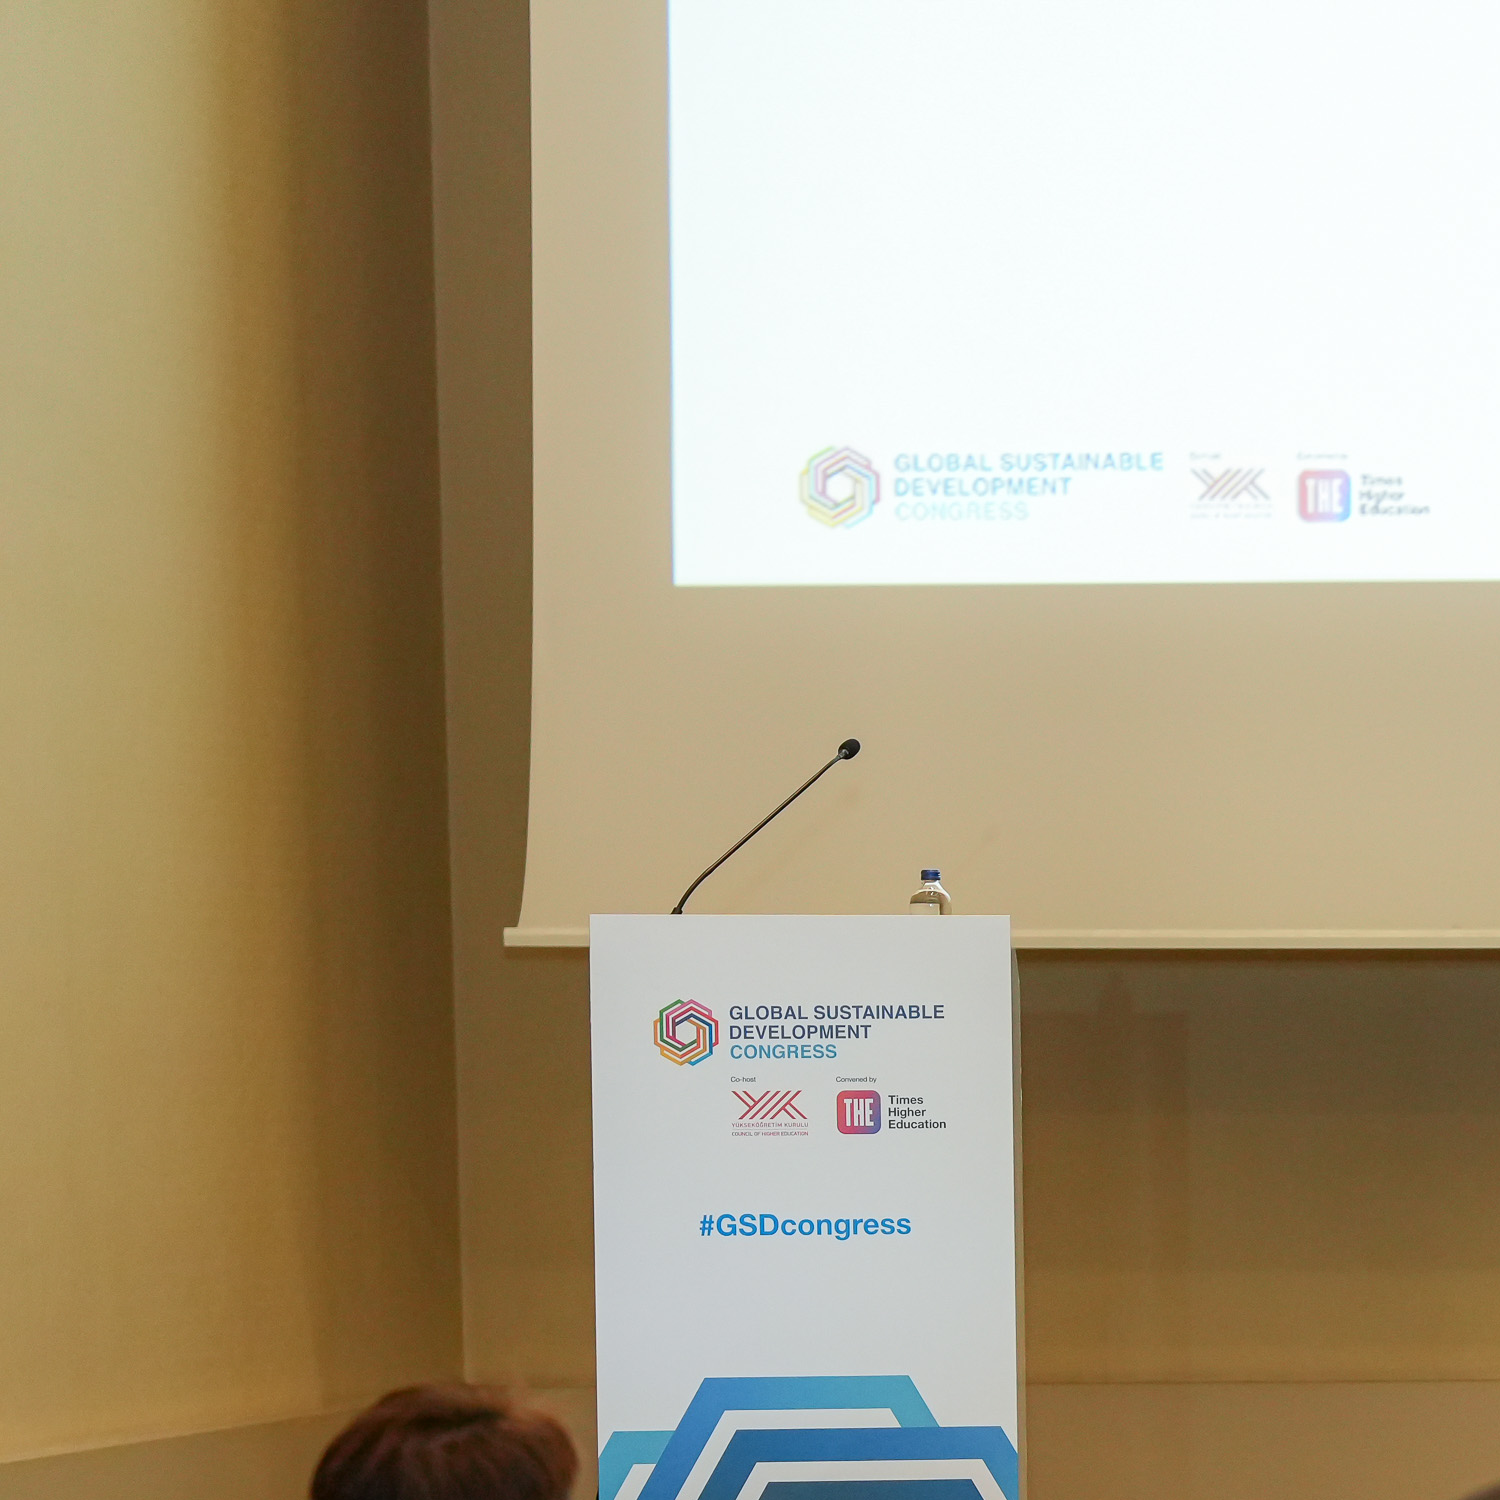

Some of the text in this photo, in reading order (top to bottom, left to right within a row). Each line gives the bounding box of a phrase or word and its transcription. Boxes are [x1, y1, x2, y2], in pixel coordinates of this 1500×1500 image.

[893, 452, 993, 472] GLOBAL
[1000, 451, 1165, 472] SUSTAINABLE
[893, 476, 1073, 497] DEVELOPMENT
[893, 501, 1031, 521] CONGRESS
[1359, 503, 1431, 516] Education
[729, 1004, 945, 1021] GLOBAL SUSTAINABLE
[729, 1024, 872, 1040] DEVELOPMENT
[729, 1044, 838, 1060] CONGRESS
[730, 1076, 757, 1084] Co-host
[868, 1076, 877, 1084] by
[887, 1094, 924, 1105] Times
[843, 1097, 875, 1128] THE
[887, 1106, 927, 1120] Higher
[887, 1118, 947, 1130] Education
[699, 1213, 912, 1241] #GSDcongress
